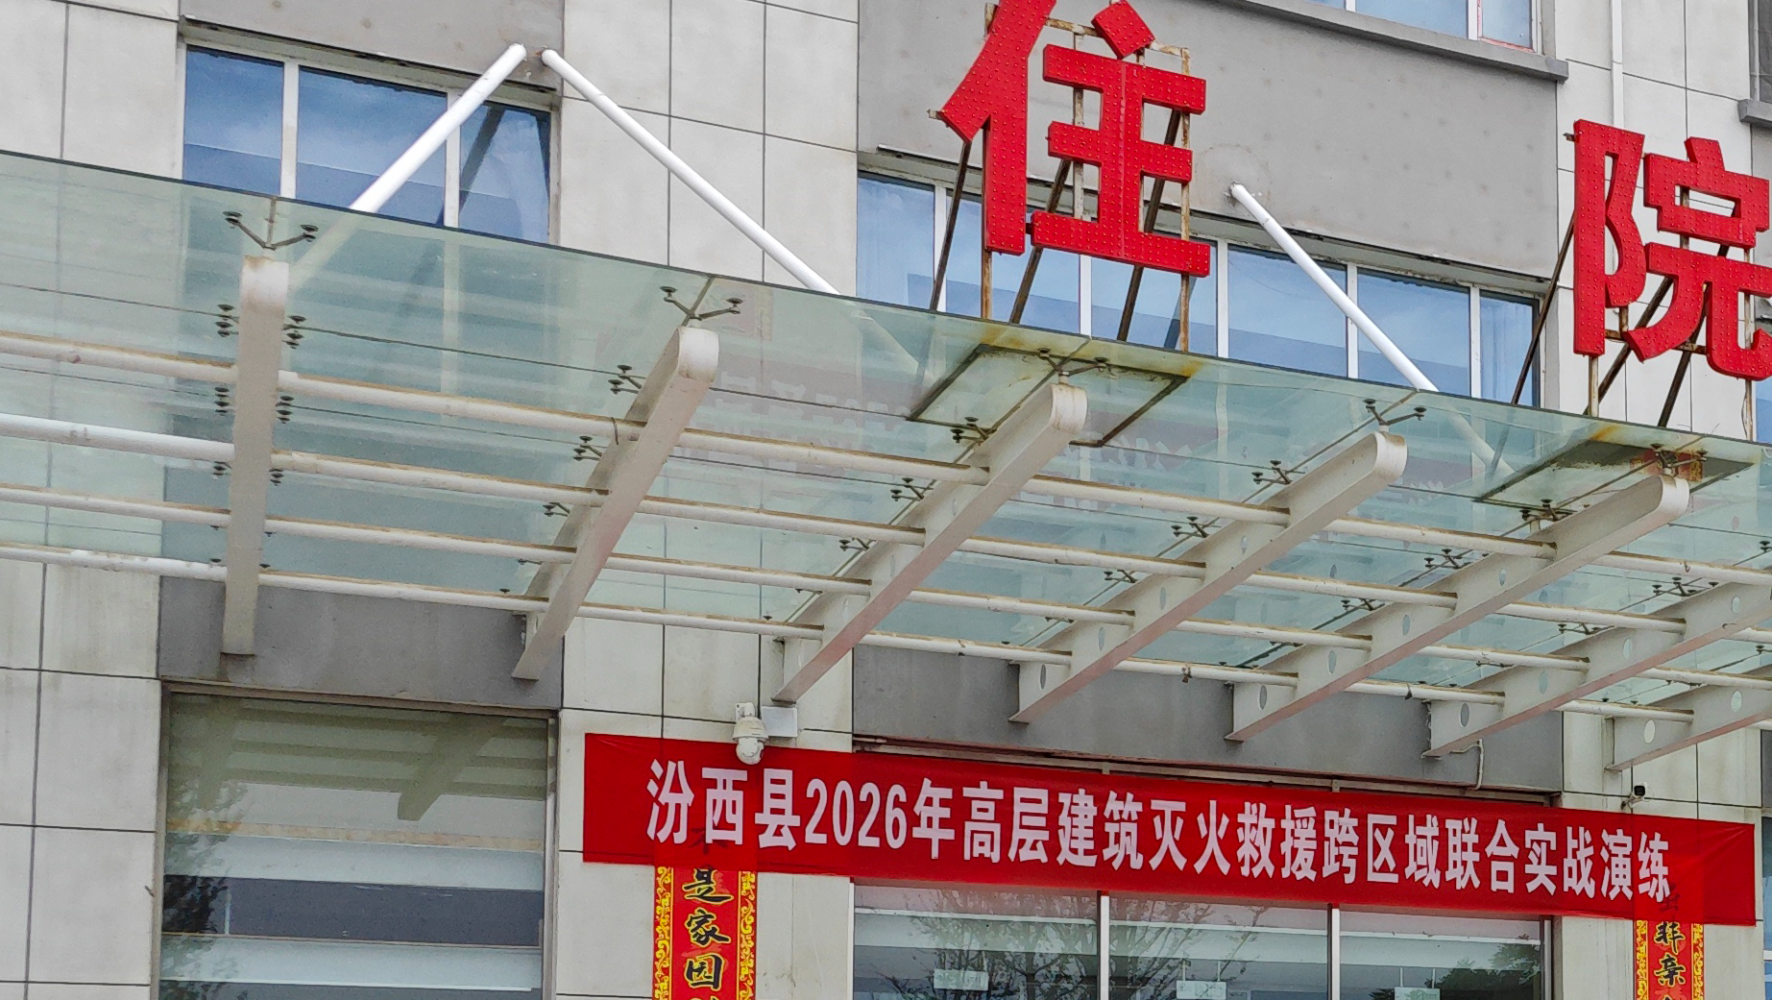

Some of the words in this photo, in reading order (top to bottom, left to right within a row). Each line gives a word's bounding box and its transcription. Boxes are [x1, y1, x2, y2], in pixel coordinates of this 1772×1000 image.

[646, 759, 1672, 903] 汾西县2026年高层建筑灭火救援跨区域联合实战演练
